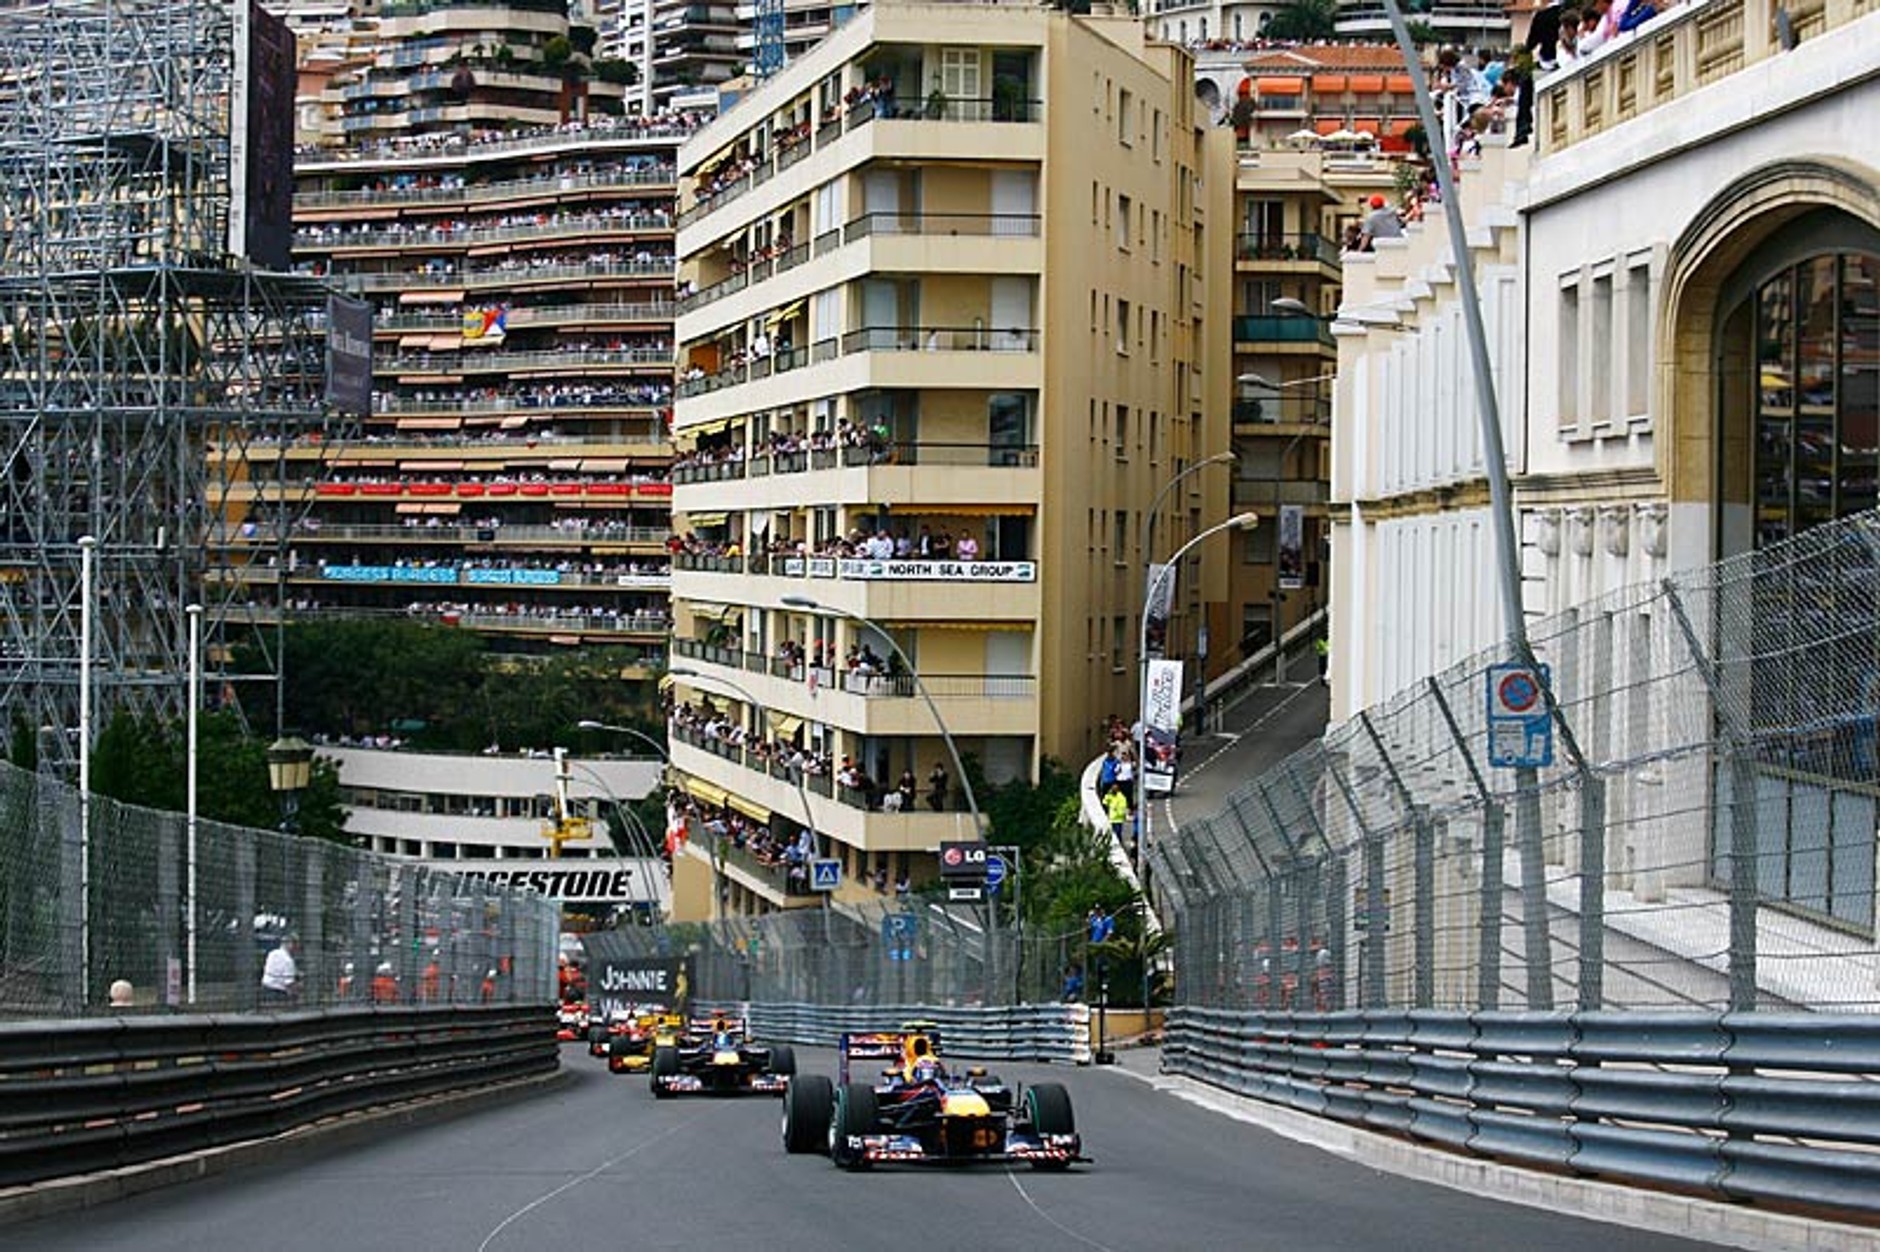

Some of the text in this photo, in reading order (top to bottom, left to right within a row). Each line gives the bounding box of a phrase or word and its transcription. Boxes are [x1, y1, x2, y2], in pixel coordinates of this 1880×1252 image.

[888, 563, 1015, 577] NORTH SEA GROUP
[964, 849, 986, 863] LG
[600, 964, 667, 991] JOHNNIE
